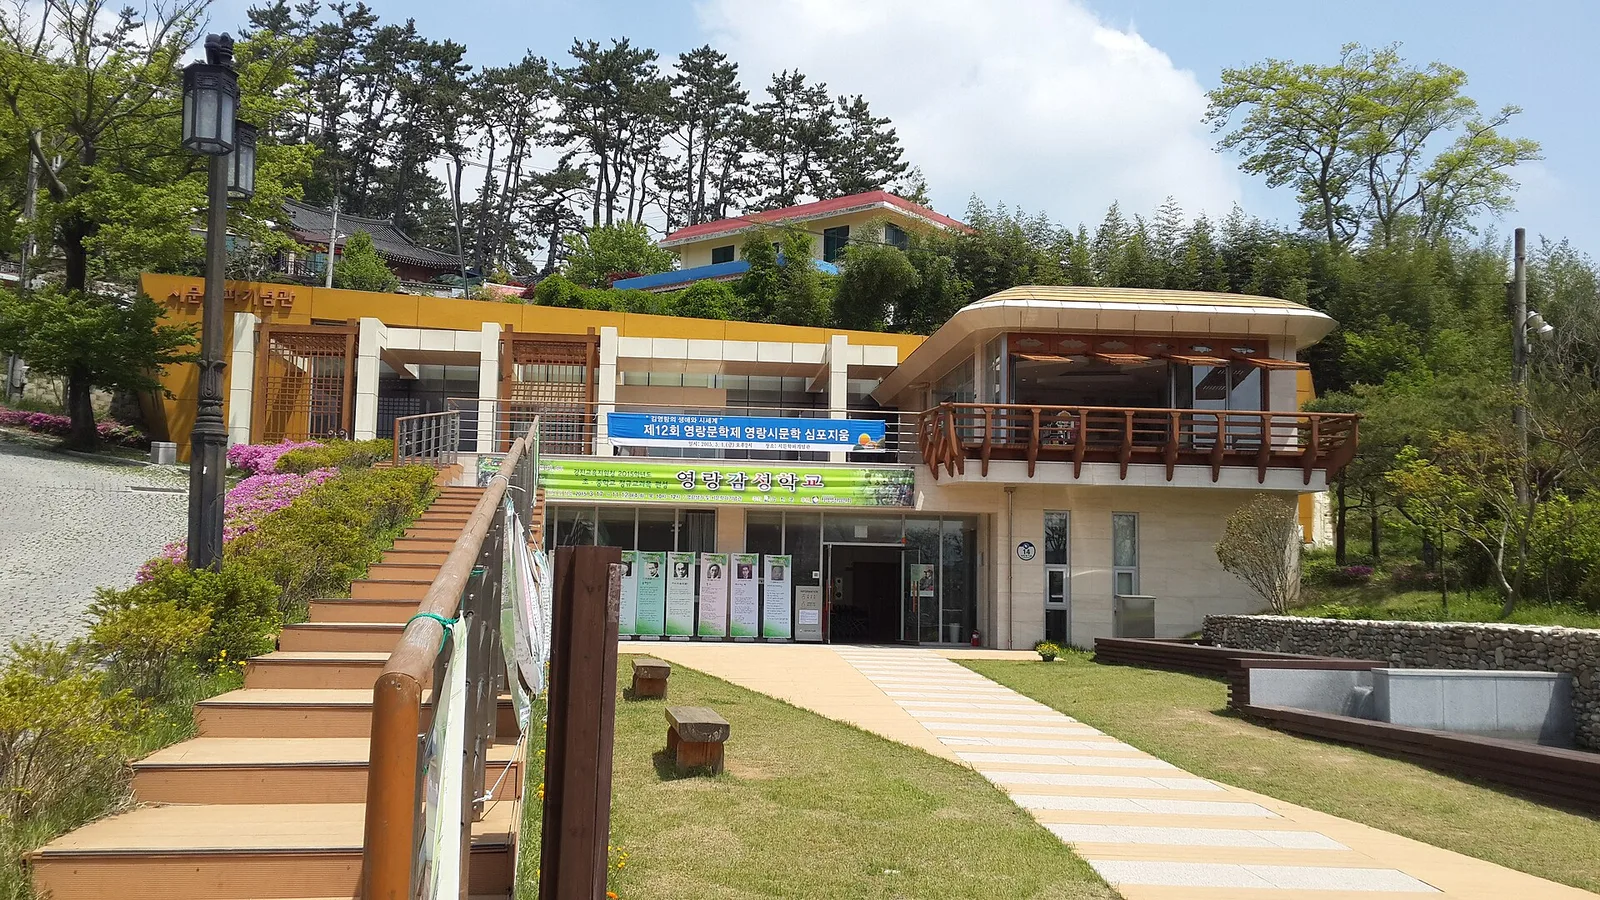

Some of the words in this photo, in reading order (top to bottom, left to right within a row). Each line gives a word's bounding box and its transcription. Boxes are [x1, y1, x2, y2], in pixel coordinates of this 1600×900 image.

[168, 284, 296, 308] 시문파기념관
[643, 423, 680, 437] 제12회
[684, 425, 741, 438] 영랑문학제
[744, 426, 801, 440] 영랑시문학
[804, 427, 850, 442] 심포지움
[676, 470, 825, 493] 영랑감성학교
